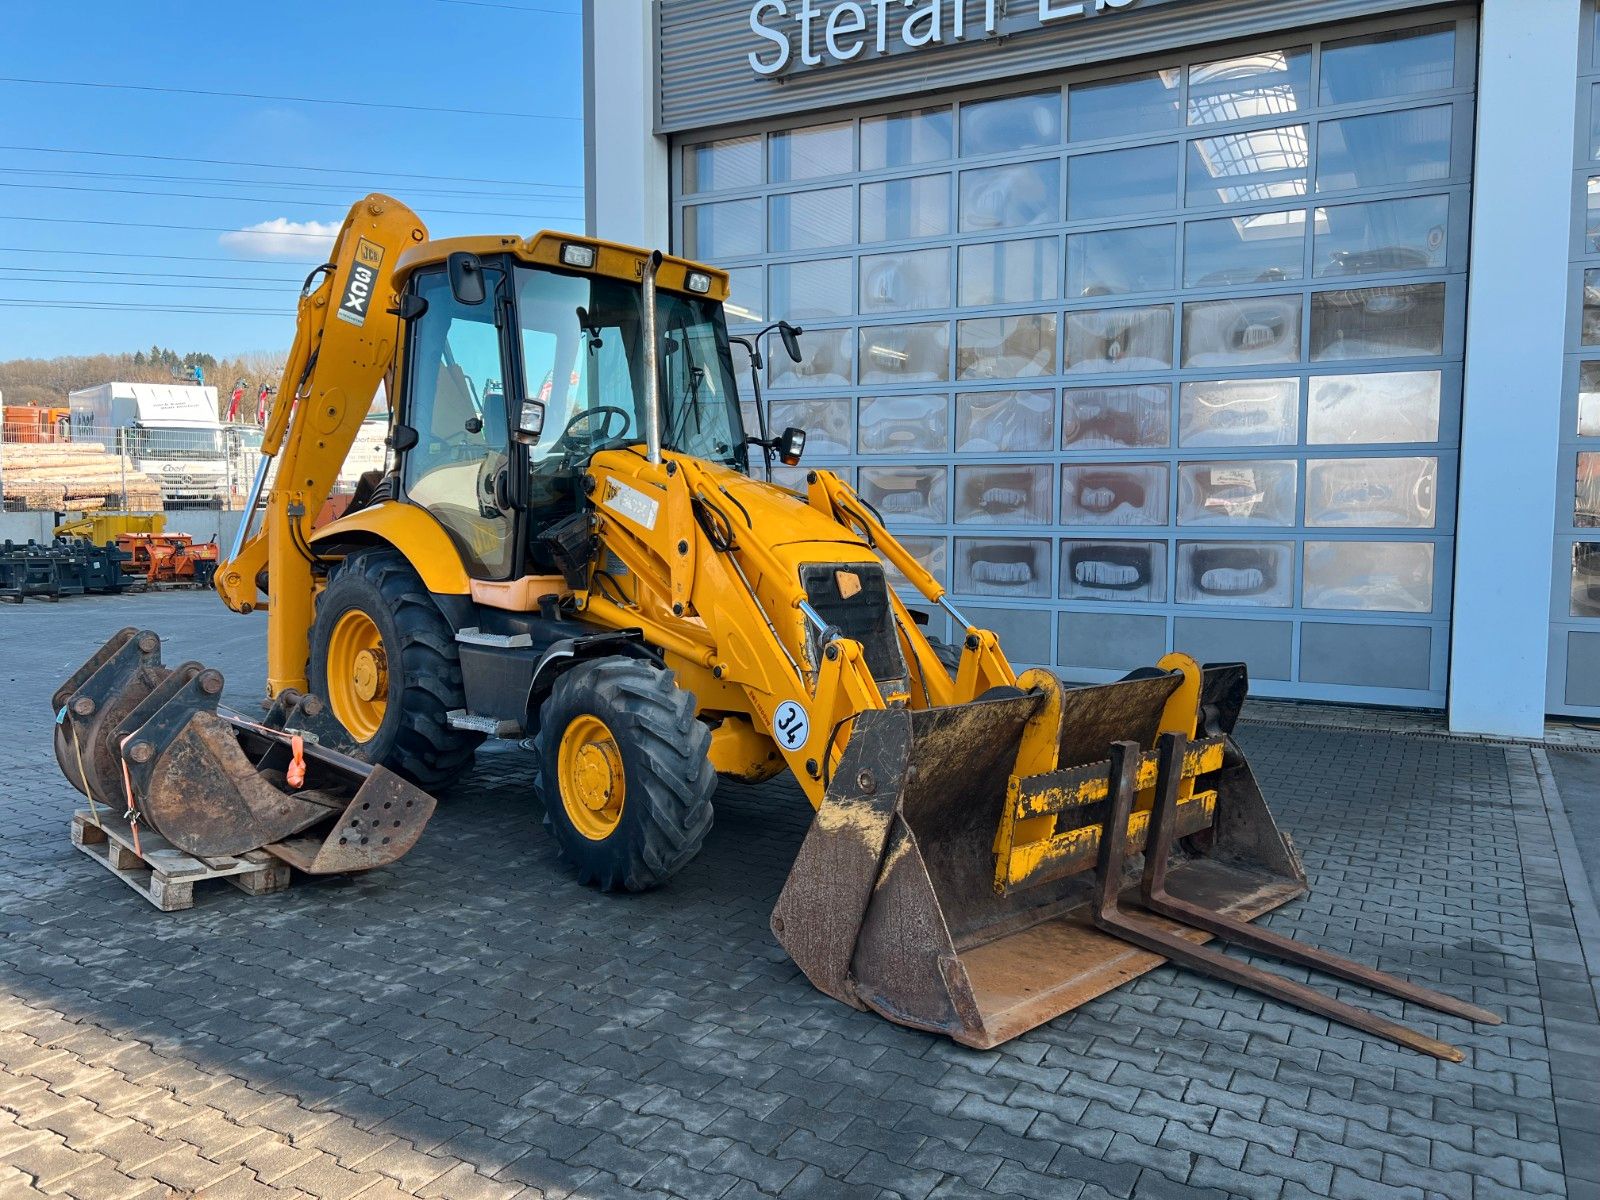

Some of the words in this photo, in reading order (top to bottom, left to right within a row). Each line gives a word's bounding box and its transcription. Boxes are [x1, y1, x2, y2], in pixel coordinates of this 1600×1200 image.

[748, 0, 996, 74] Stefan
[344, 266, 372, 312] 3CX
[778, 707, 804, 744] 34
